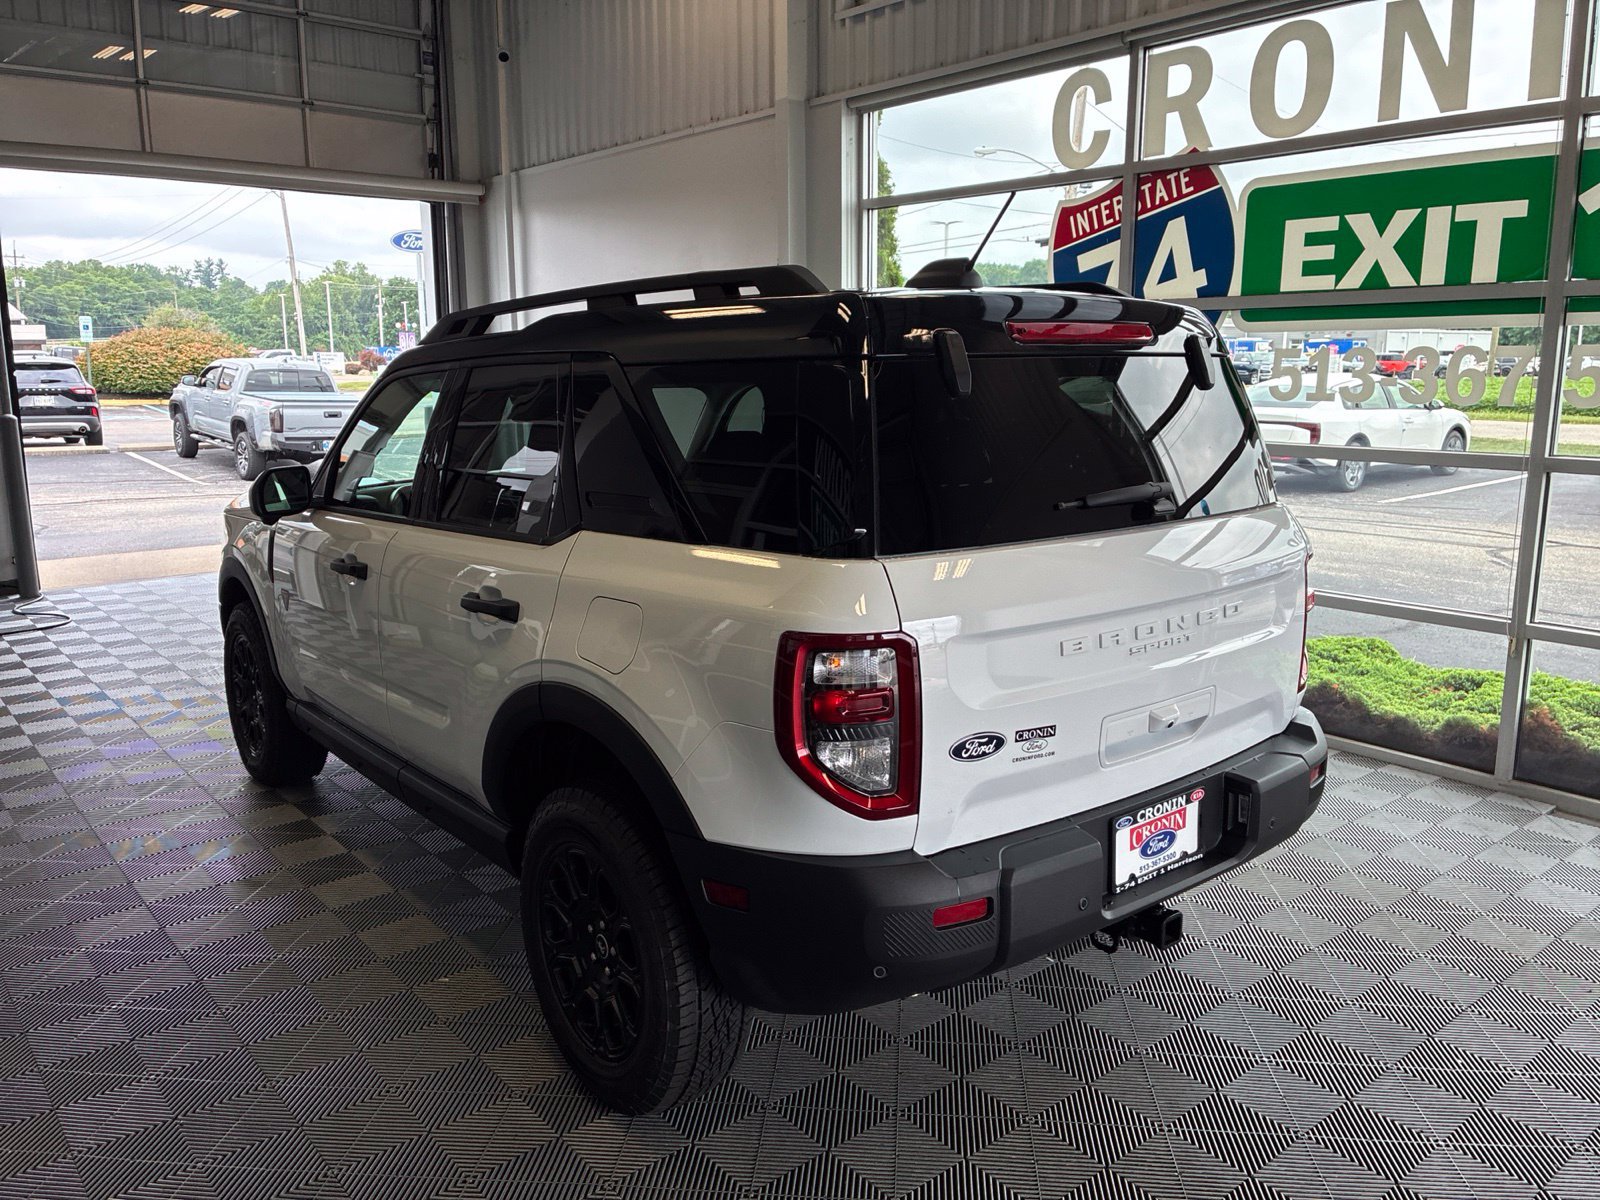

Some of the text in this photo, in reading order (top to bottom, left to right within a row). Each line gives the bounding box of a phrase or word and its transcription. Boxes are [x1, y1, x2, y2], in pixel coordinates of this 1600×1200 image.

[1069, 168, 1194, 239] INTERTATE
[1280, 200, 1529, 292] EXIT
[1060, 600, 1246, 656] BRONCO
[1129, 632, 1196, 656] SPORT
[1016, 727, 1055, 741] CRONIN
[962, 738, 996, 757] Ford
[1012, 751, 1055, 763] CRONINFORD.COM
[1137, 795, 1187, 822] CRONIN
[1132, 811, 1185, 848] CRONIN
[1147, 834, 1170, 854] Ford
[1116, 881, 1136, 893] I-74
[1138, 871, 1158, 884] EXIT
[1167, 853, 1203, 870] Harrison
[1139, 851, 1177, 873] 513-367-5300
